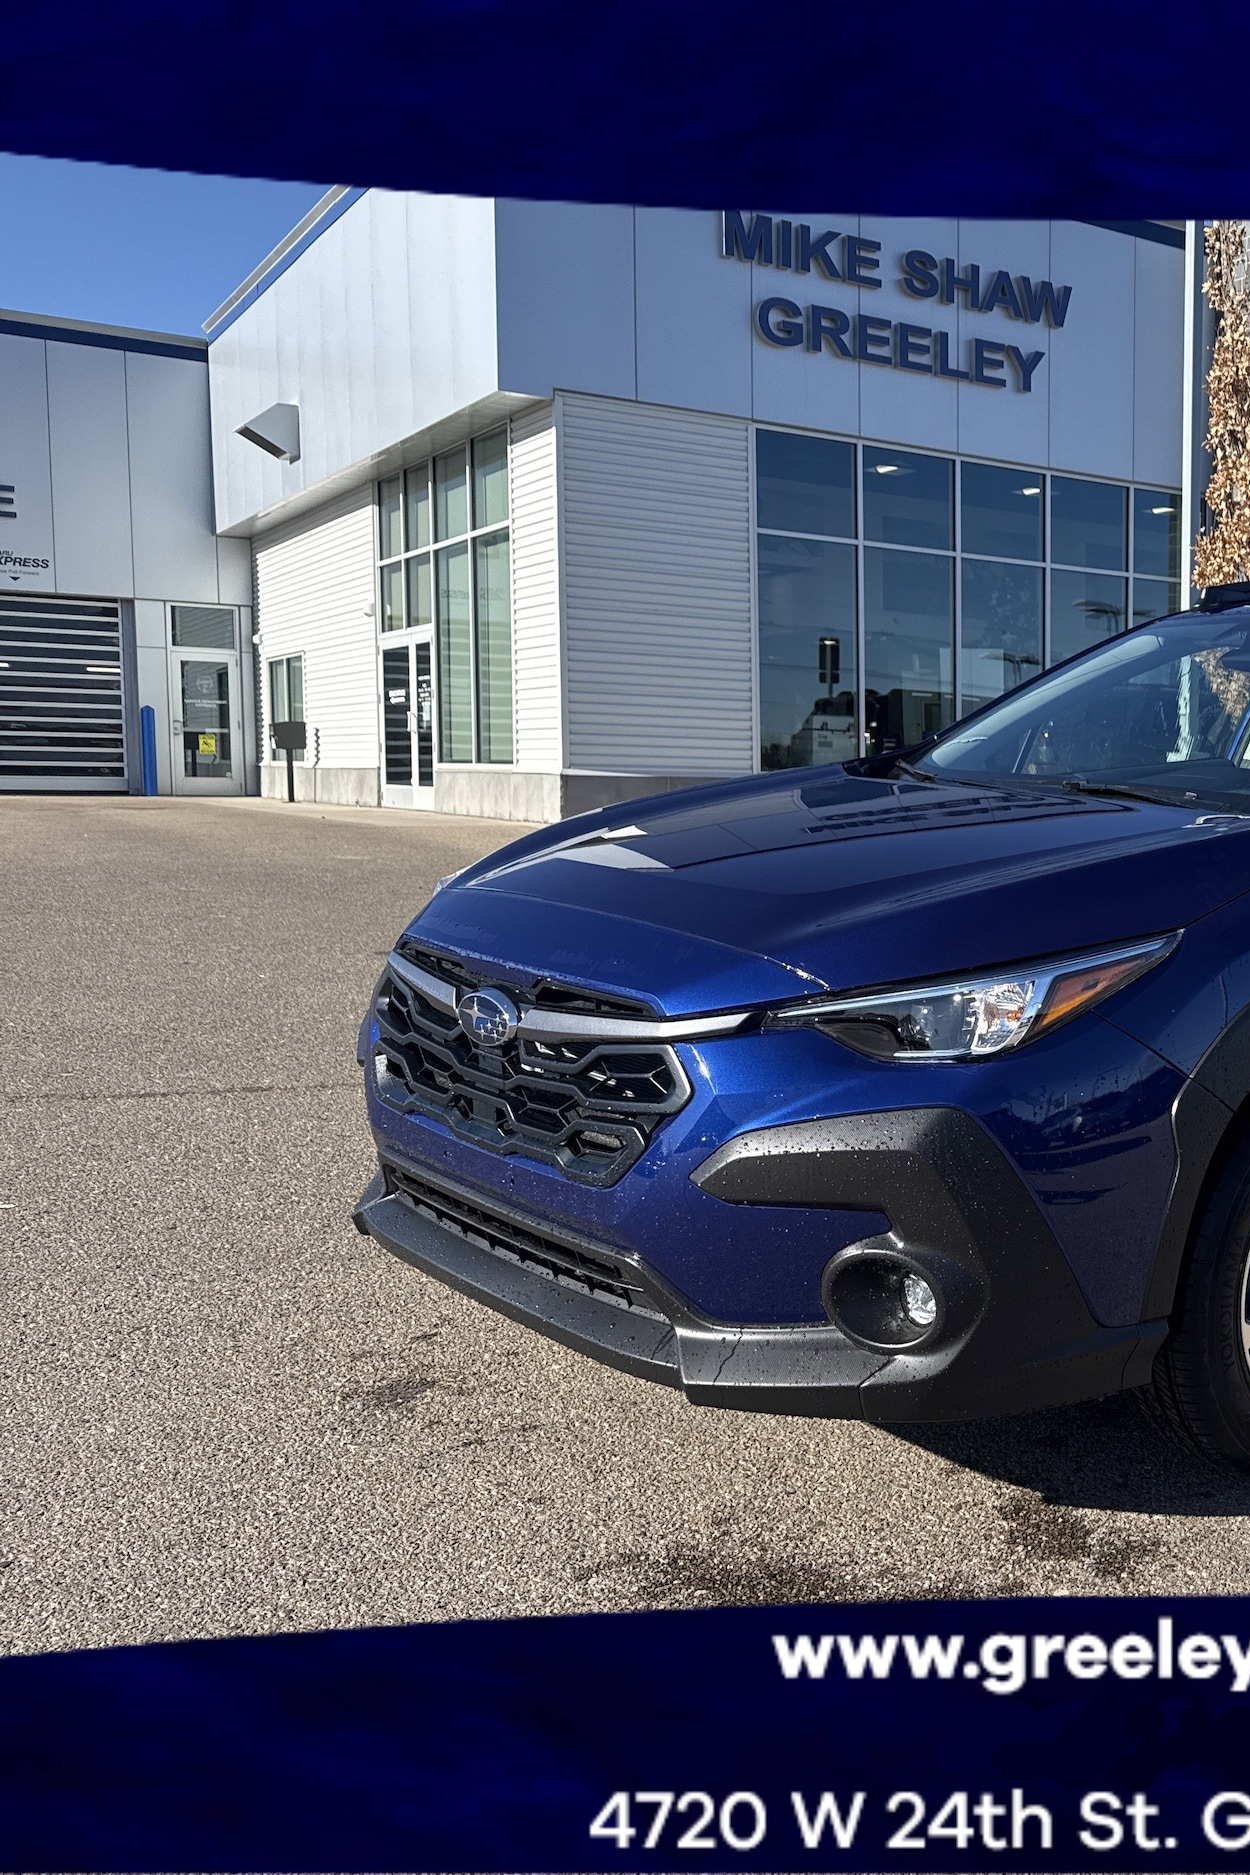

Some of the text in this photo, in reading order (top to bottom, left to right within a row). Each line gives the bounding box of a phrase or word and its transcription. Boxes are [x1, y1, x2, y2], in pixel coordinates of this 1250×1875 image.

[722, 209, 1073, 329] MIKE SHAW
[755, 296, 1046, 394] GREELEY
[1218, 1233, 1245, 1375] YOKOHAMA
